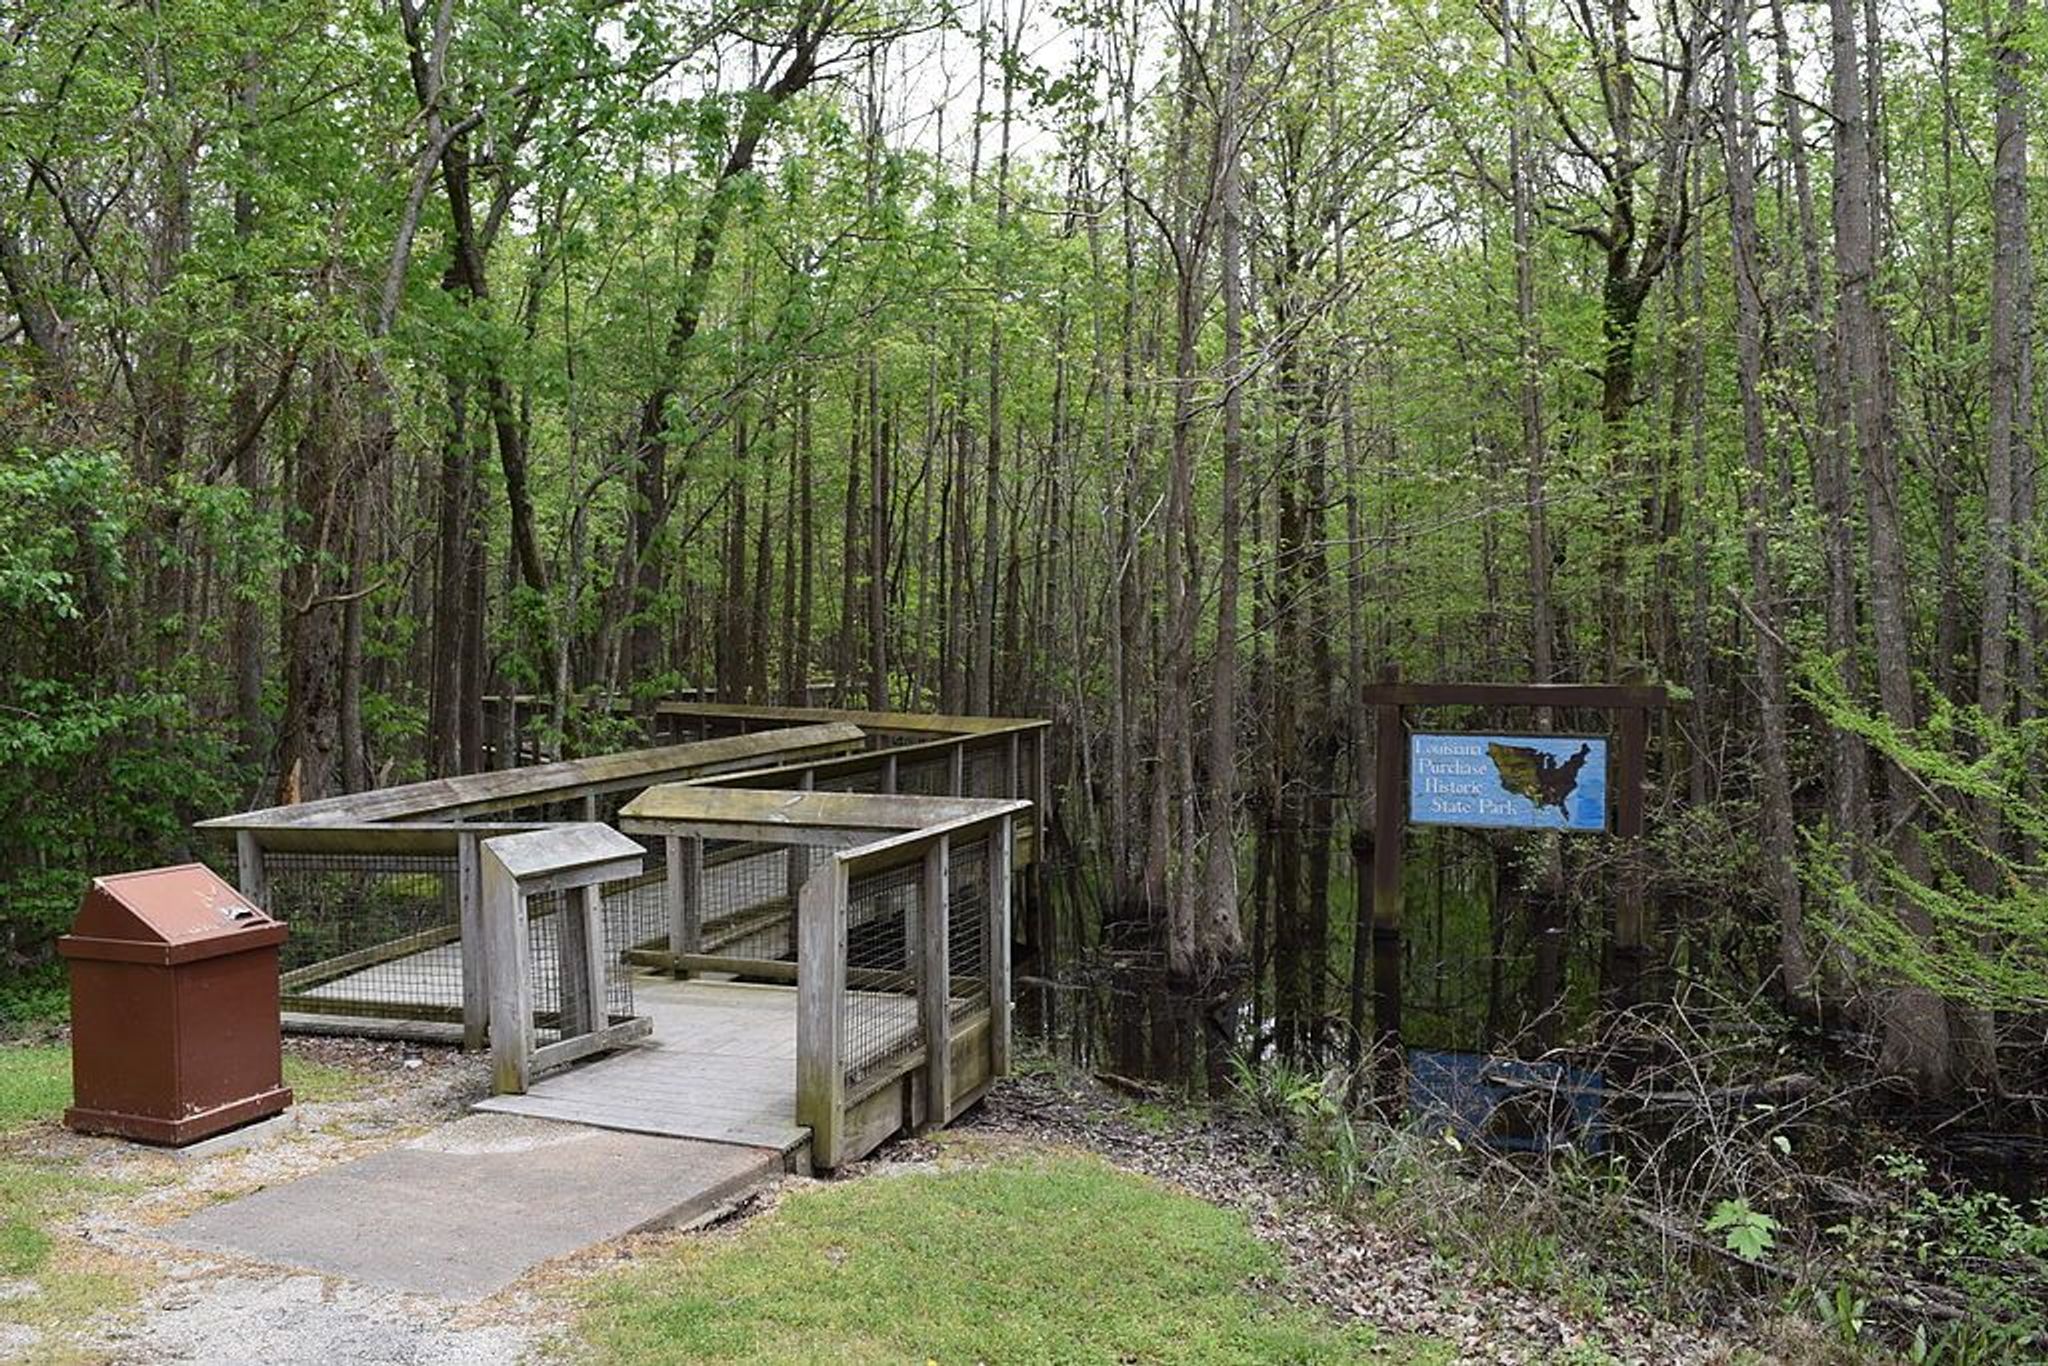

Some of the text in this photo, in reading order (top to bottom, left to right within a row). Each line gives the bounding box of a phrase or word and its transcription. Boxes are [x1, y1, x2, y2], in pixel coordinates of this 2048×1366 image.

[1415, 740, 1482, 756] Louisiana
[1419, 758, 1487, 776] Purchase
[1425, 777, 1484, 795] Historic
[1430, 798, 1518, 816] State Park
